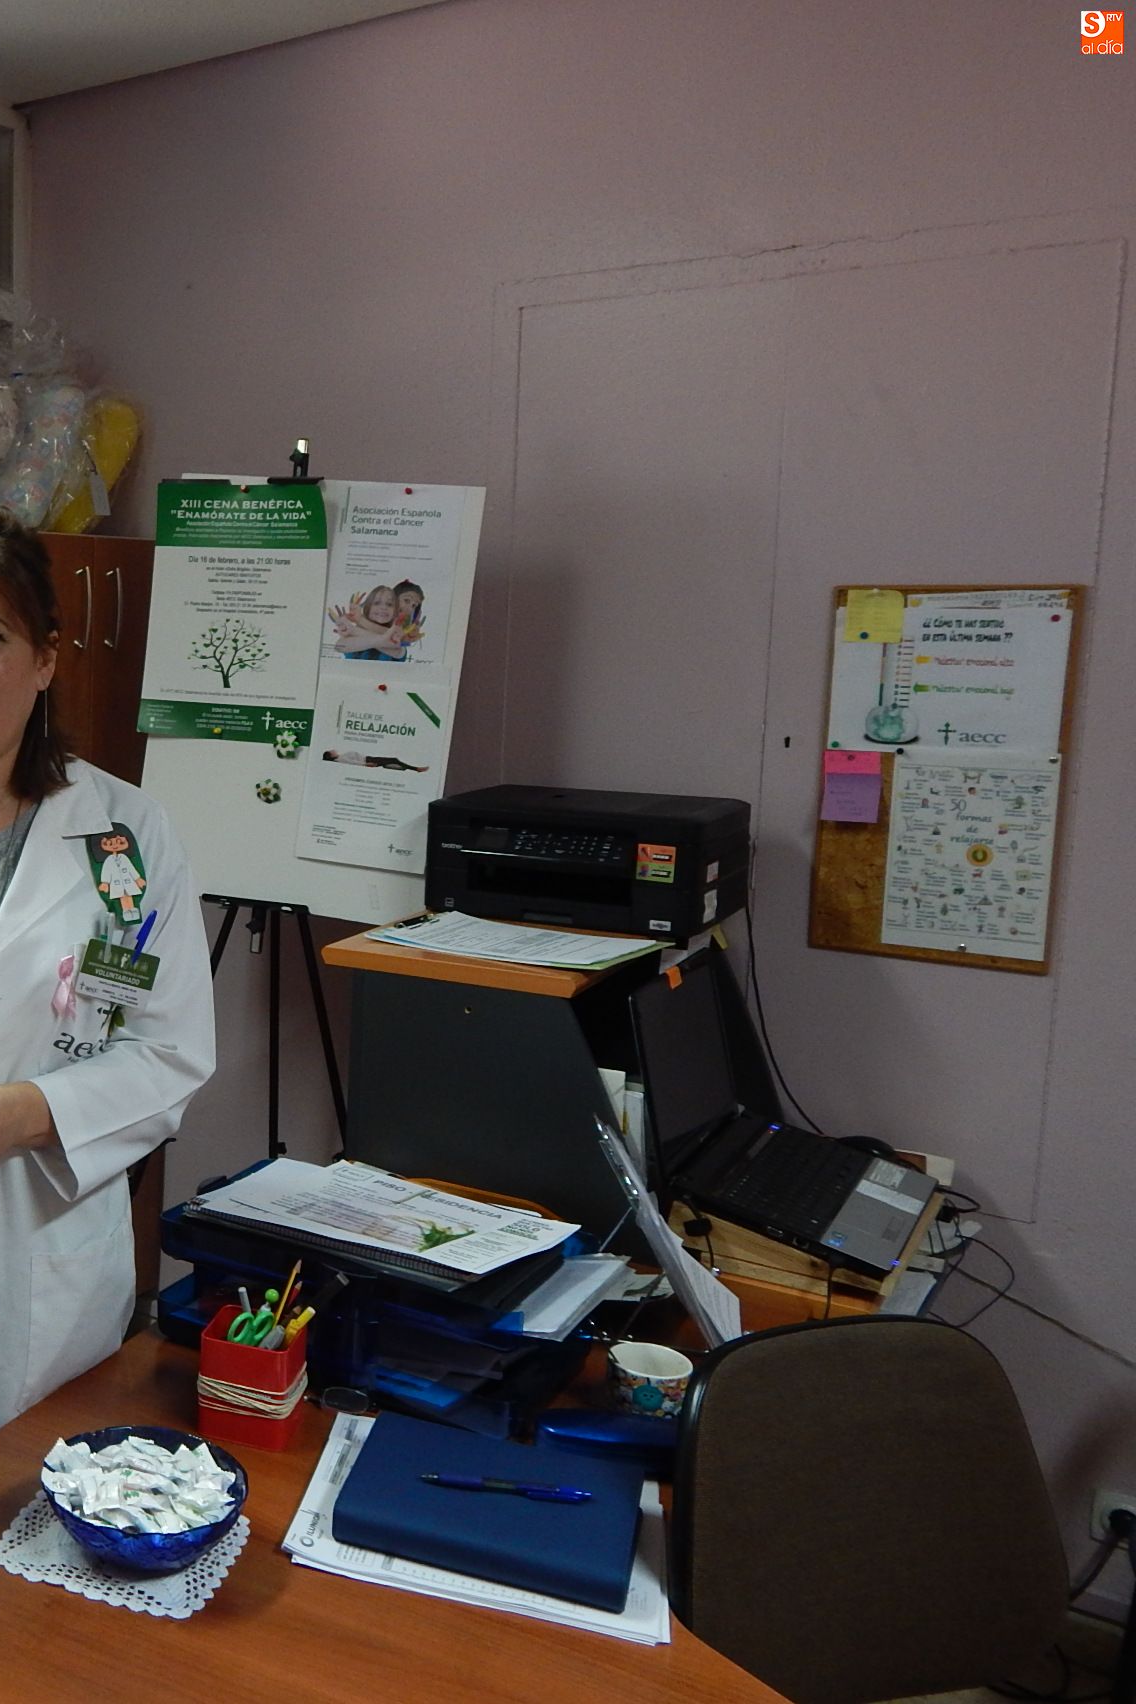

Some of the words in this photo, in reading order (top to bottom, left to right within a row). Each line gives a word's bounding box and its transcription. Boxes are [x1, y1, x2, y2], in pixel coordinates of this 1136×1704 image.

[180, 499, 202, 509] XIII
[204, 499, 240, 510] CENA
[242, 498, 304, 510] BENÉFICA
[171, 510, 247, 521] "ENAMÓRATE
[248, 512, 265, 521] DE
[266, 512, 281, 521] LA
[282, 511, 312, 521] VIDA"
[352, 506, 399, 516] Asociación
[401, 508, 442, 519] Española
[351, 515, 382, 525] Contra
[383, 517, 392, 526] el
[393, 516, 425, 527] Cáncer
[351, 526, 399, 537] Salamanca
[275, 719, 308, 730] aecc
[345, 719, 416, 737] RELAJACIÓN
[959, 732, 1007, 744] aecc
[95, 968, 141, 986] VOLUNTARIADO
